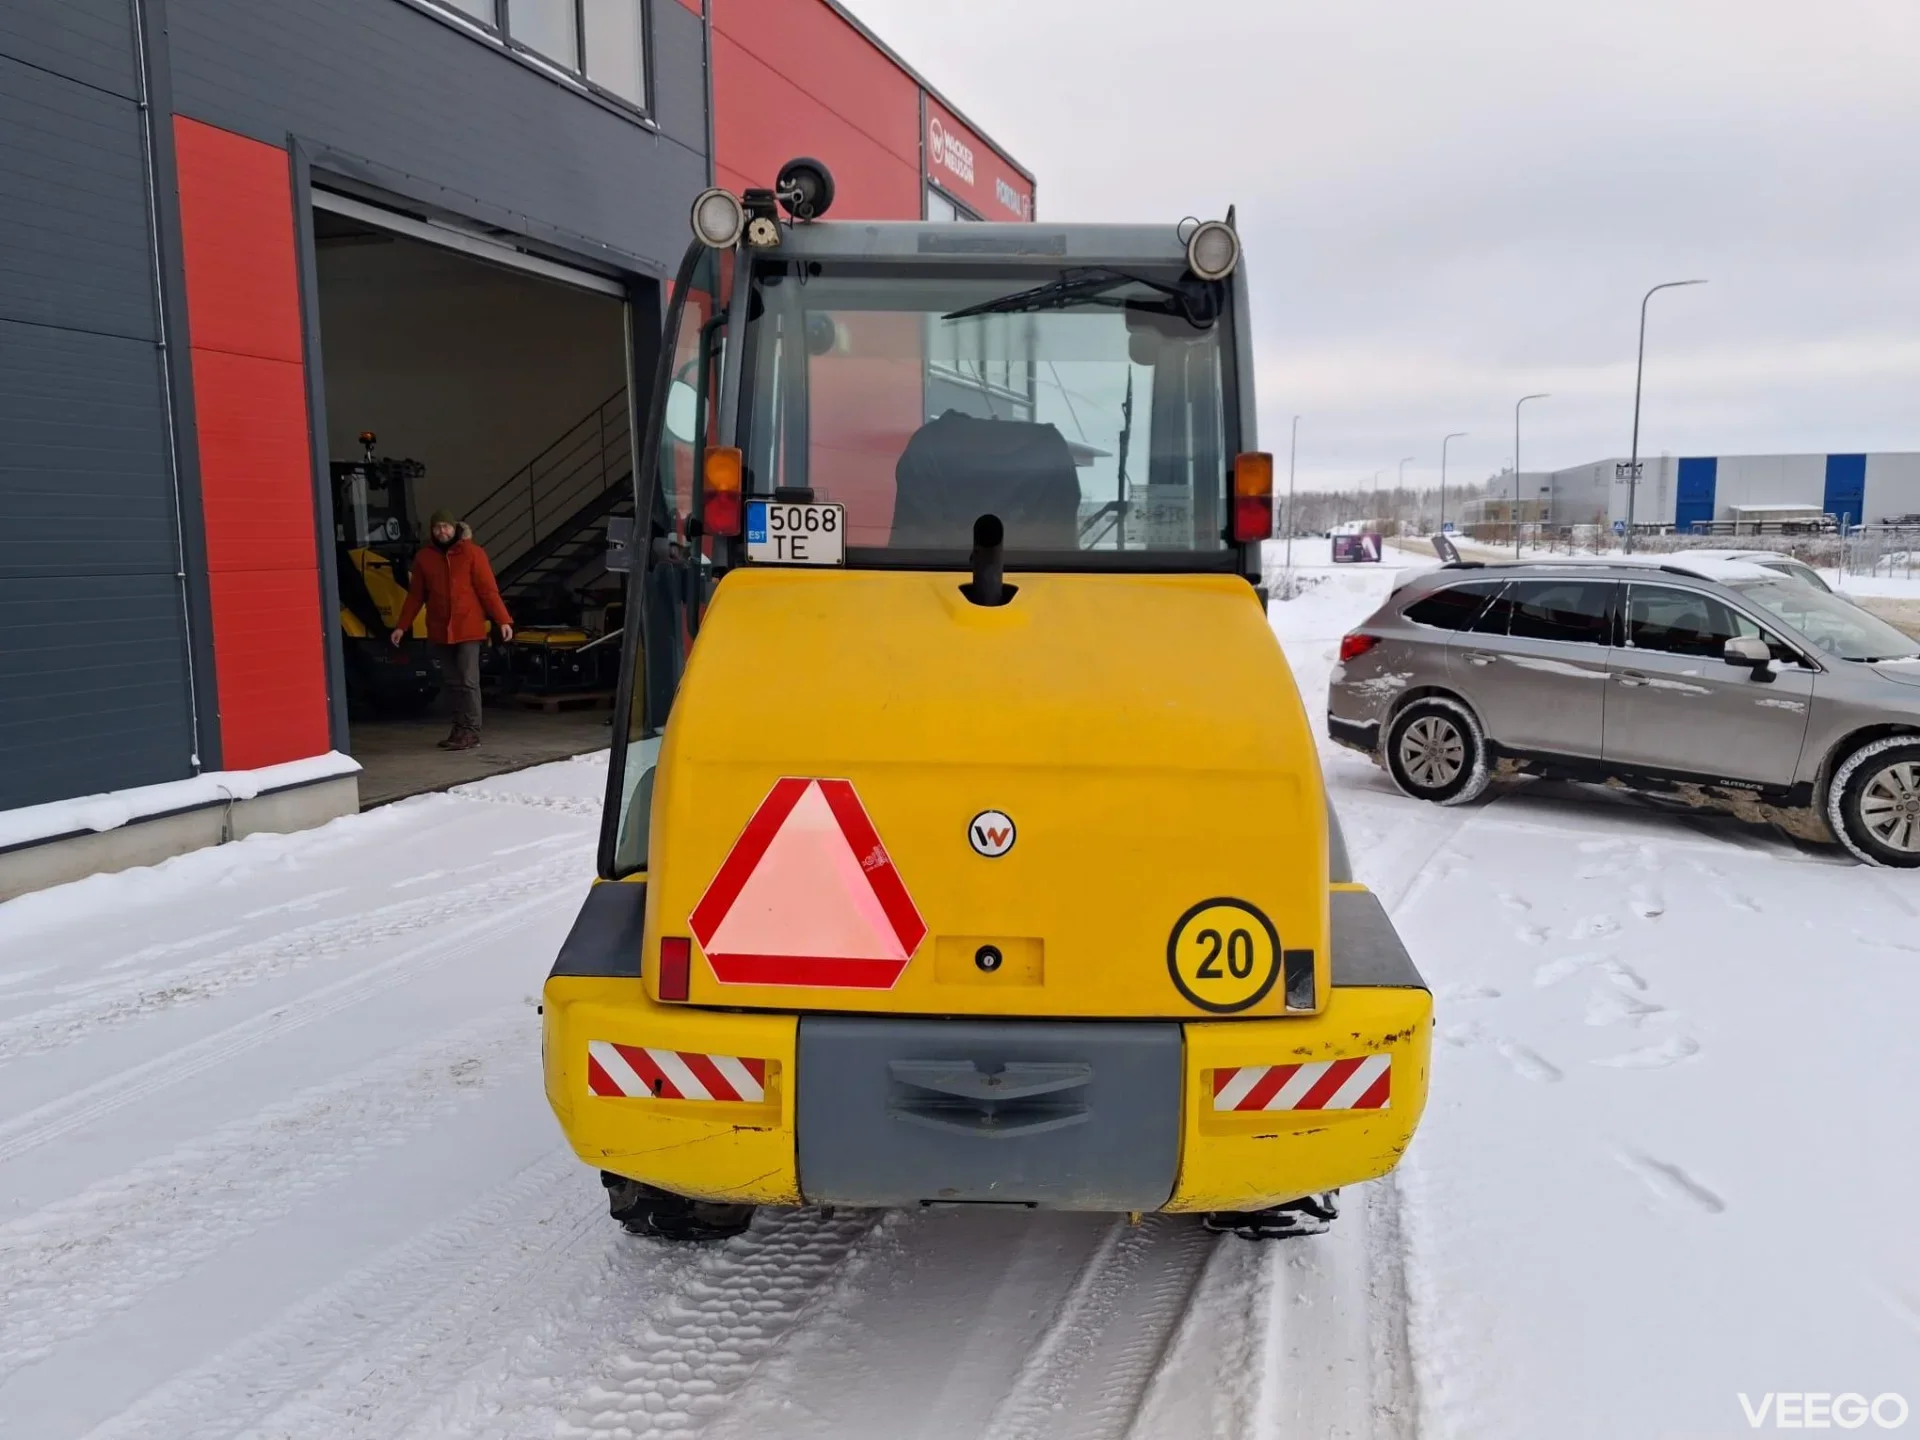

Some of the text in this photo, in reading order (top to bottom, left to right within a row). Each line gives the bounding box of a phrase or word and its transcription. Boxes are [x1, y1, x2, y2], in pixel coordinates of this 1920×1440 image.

[770, 506, 837, 532] 5068
[748, 531, 766, 540] EST
[773, 534, 809, 560] TE
[1195, 928, 1254, 979] 20
